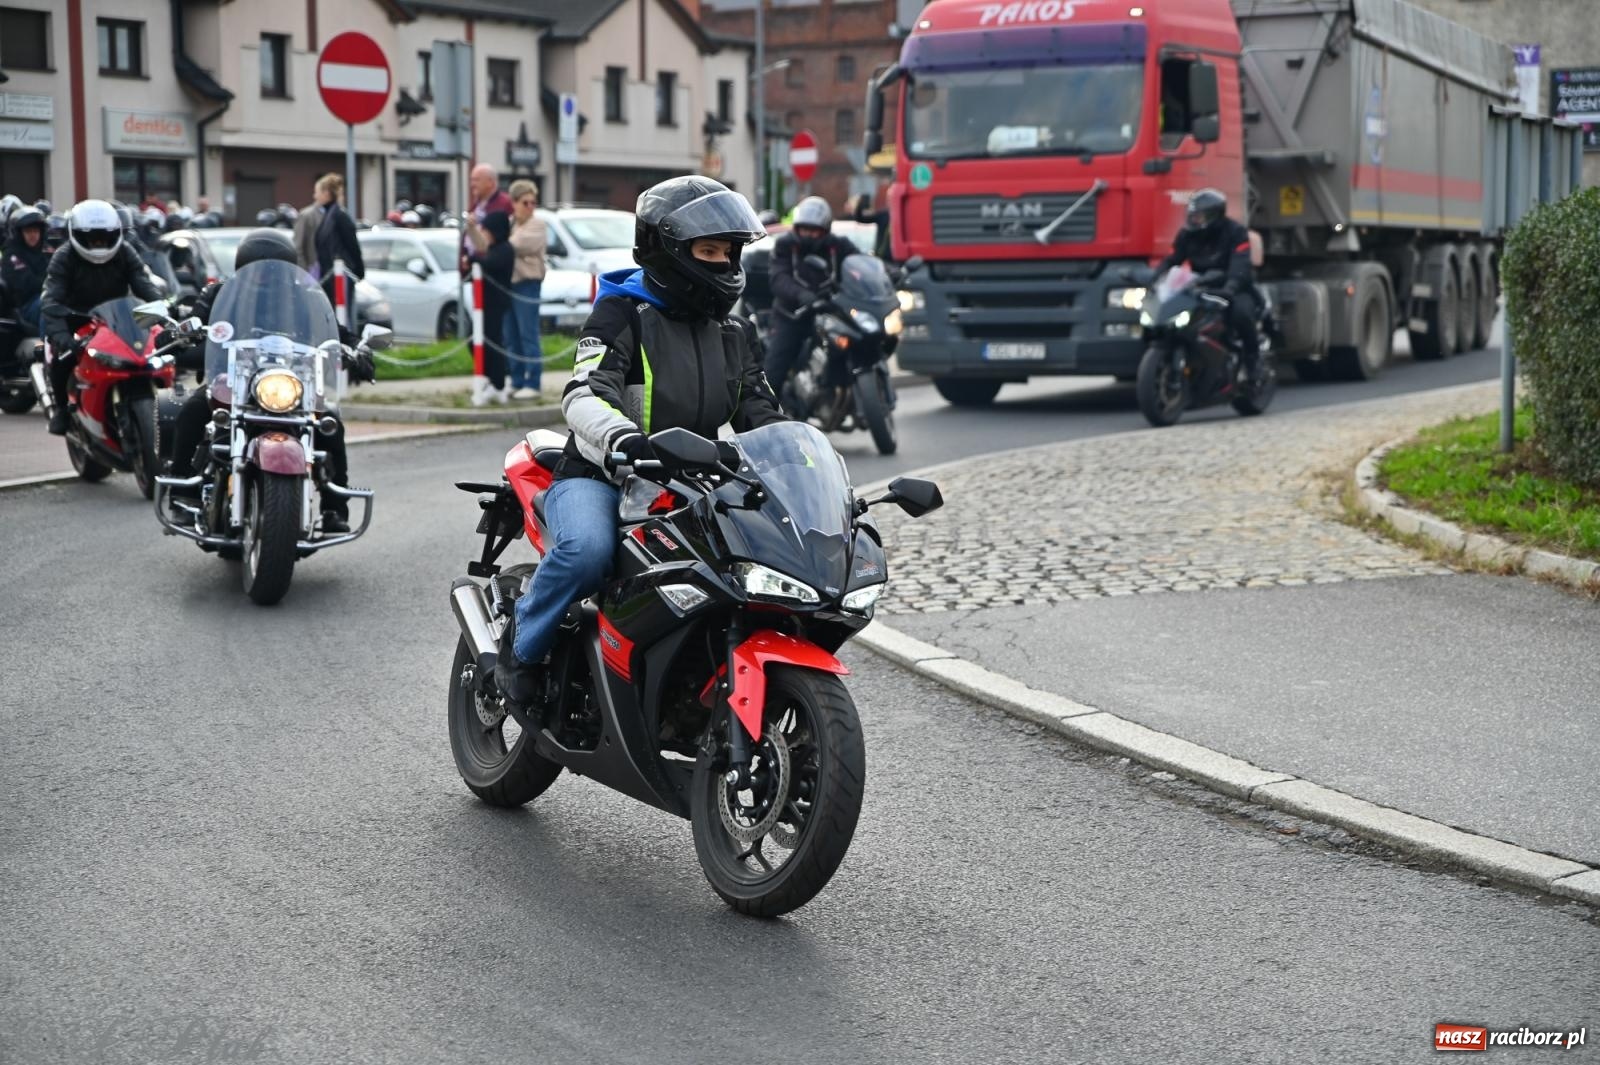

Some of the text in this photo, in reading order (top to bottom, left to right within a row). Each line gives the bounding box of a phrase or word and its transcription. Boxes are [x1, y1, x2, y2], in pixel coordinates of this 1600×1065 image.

[979, 0, 1076, 25] PAKOS
[123, 113, 182, 137] dentica
[981, 203, 1042, 217] MAN
